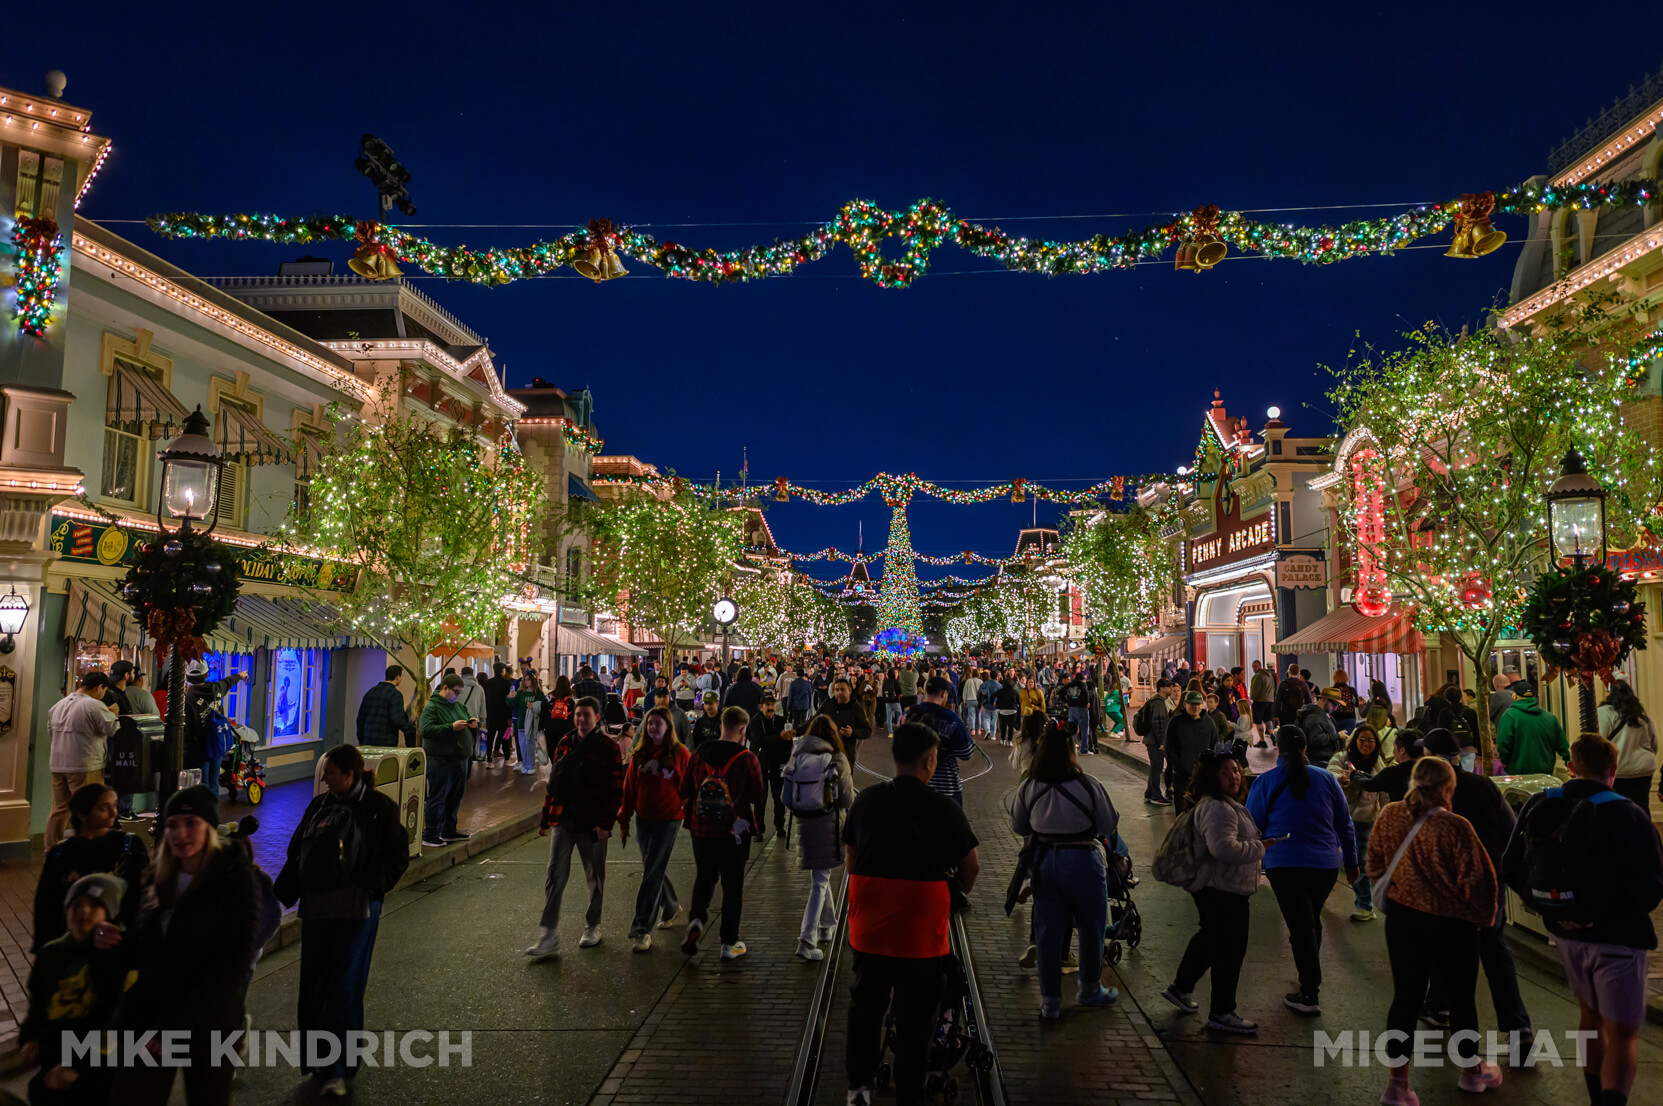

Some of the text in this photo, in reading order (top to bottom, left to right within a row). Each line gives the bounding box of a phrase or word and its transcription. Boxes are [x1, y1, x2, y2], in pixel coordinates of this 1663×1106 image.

[1192, 521, 1269, 565] PENNY ARCADE
[1283, 564, 1319, 573] CANDY
[1281, 573, 1322, 581] PALACE
